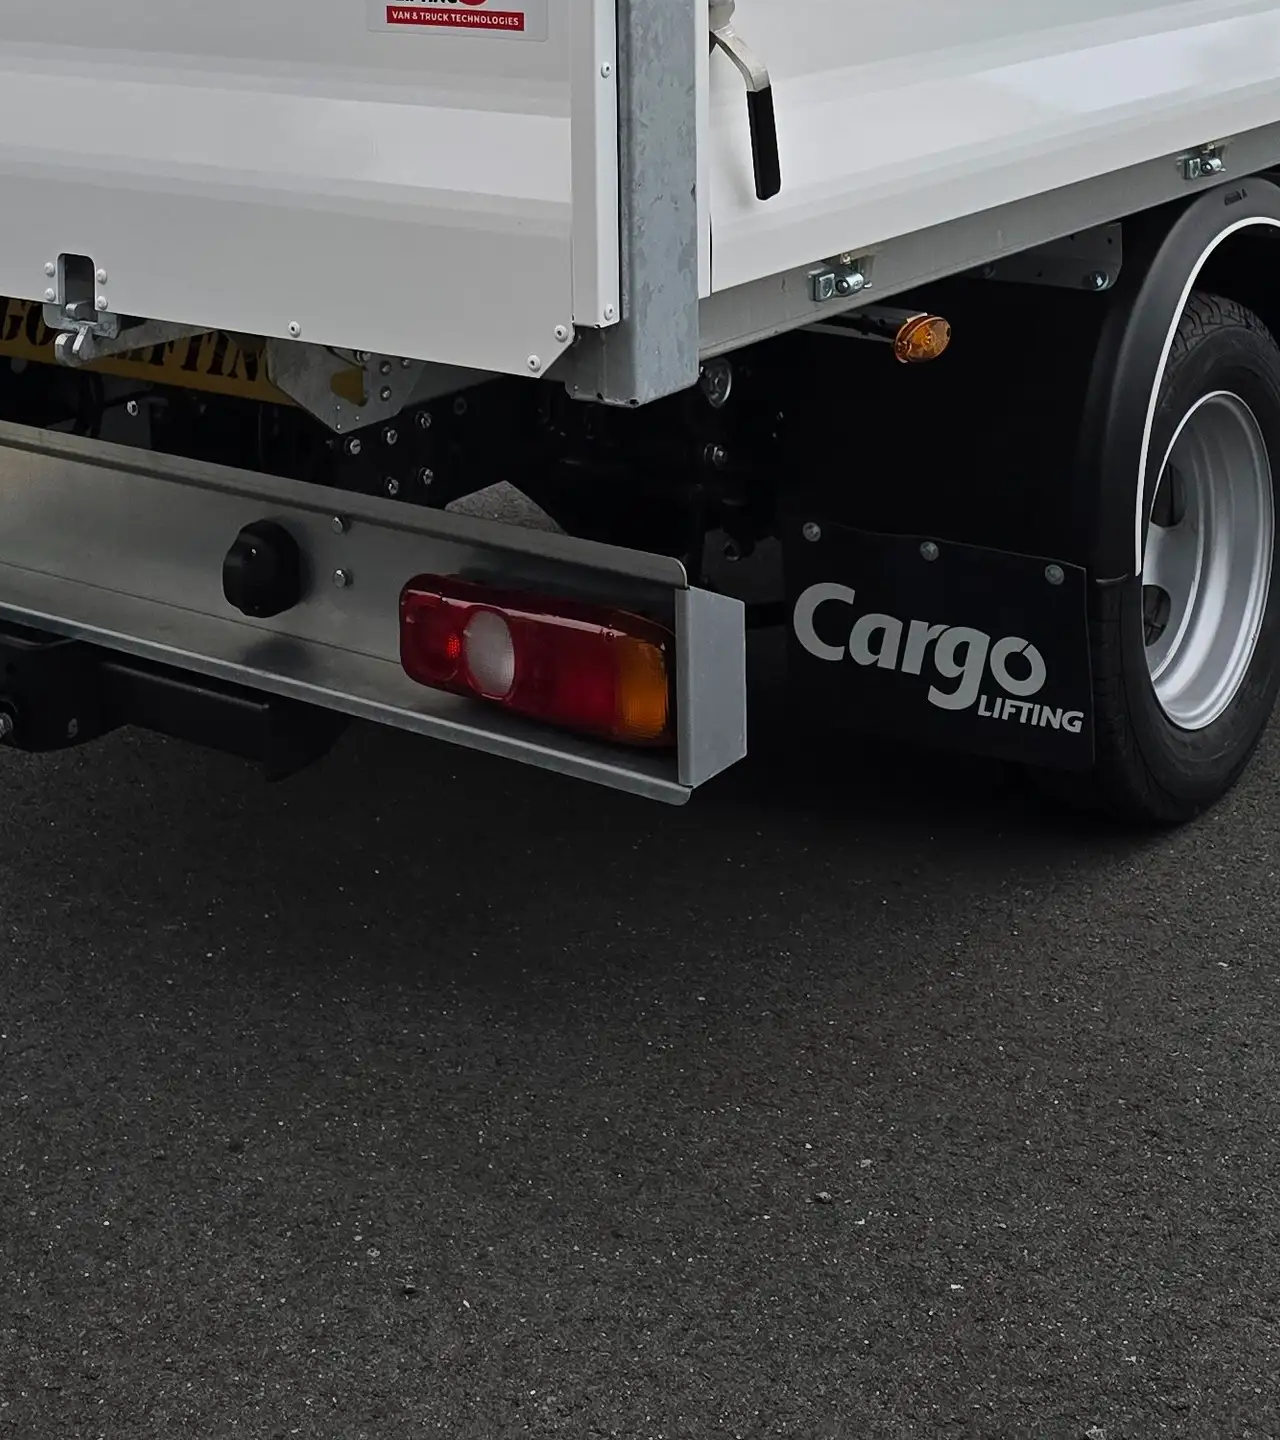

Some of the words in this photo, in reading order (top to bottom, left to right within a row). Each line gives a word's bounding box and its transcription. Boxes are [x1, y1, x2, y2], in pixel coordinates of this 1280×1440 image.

[392, 10, 410, 20] VAN
[412, 11, 418, 20] &
[420, 12, 450, 22] TRUCK
[451, 13, 519, 26] TECHNOLOGIES
[793, 582, 1047, 711] Cargo
[977, 694, 1084, 733] LIFTING
